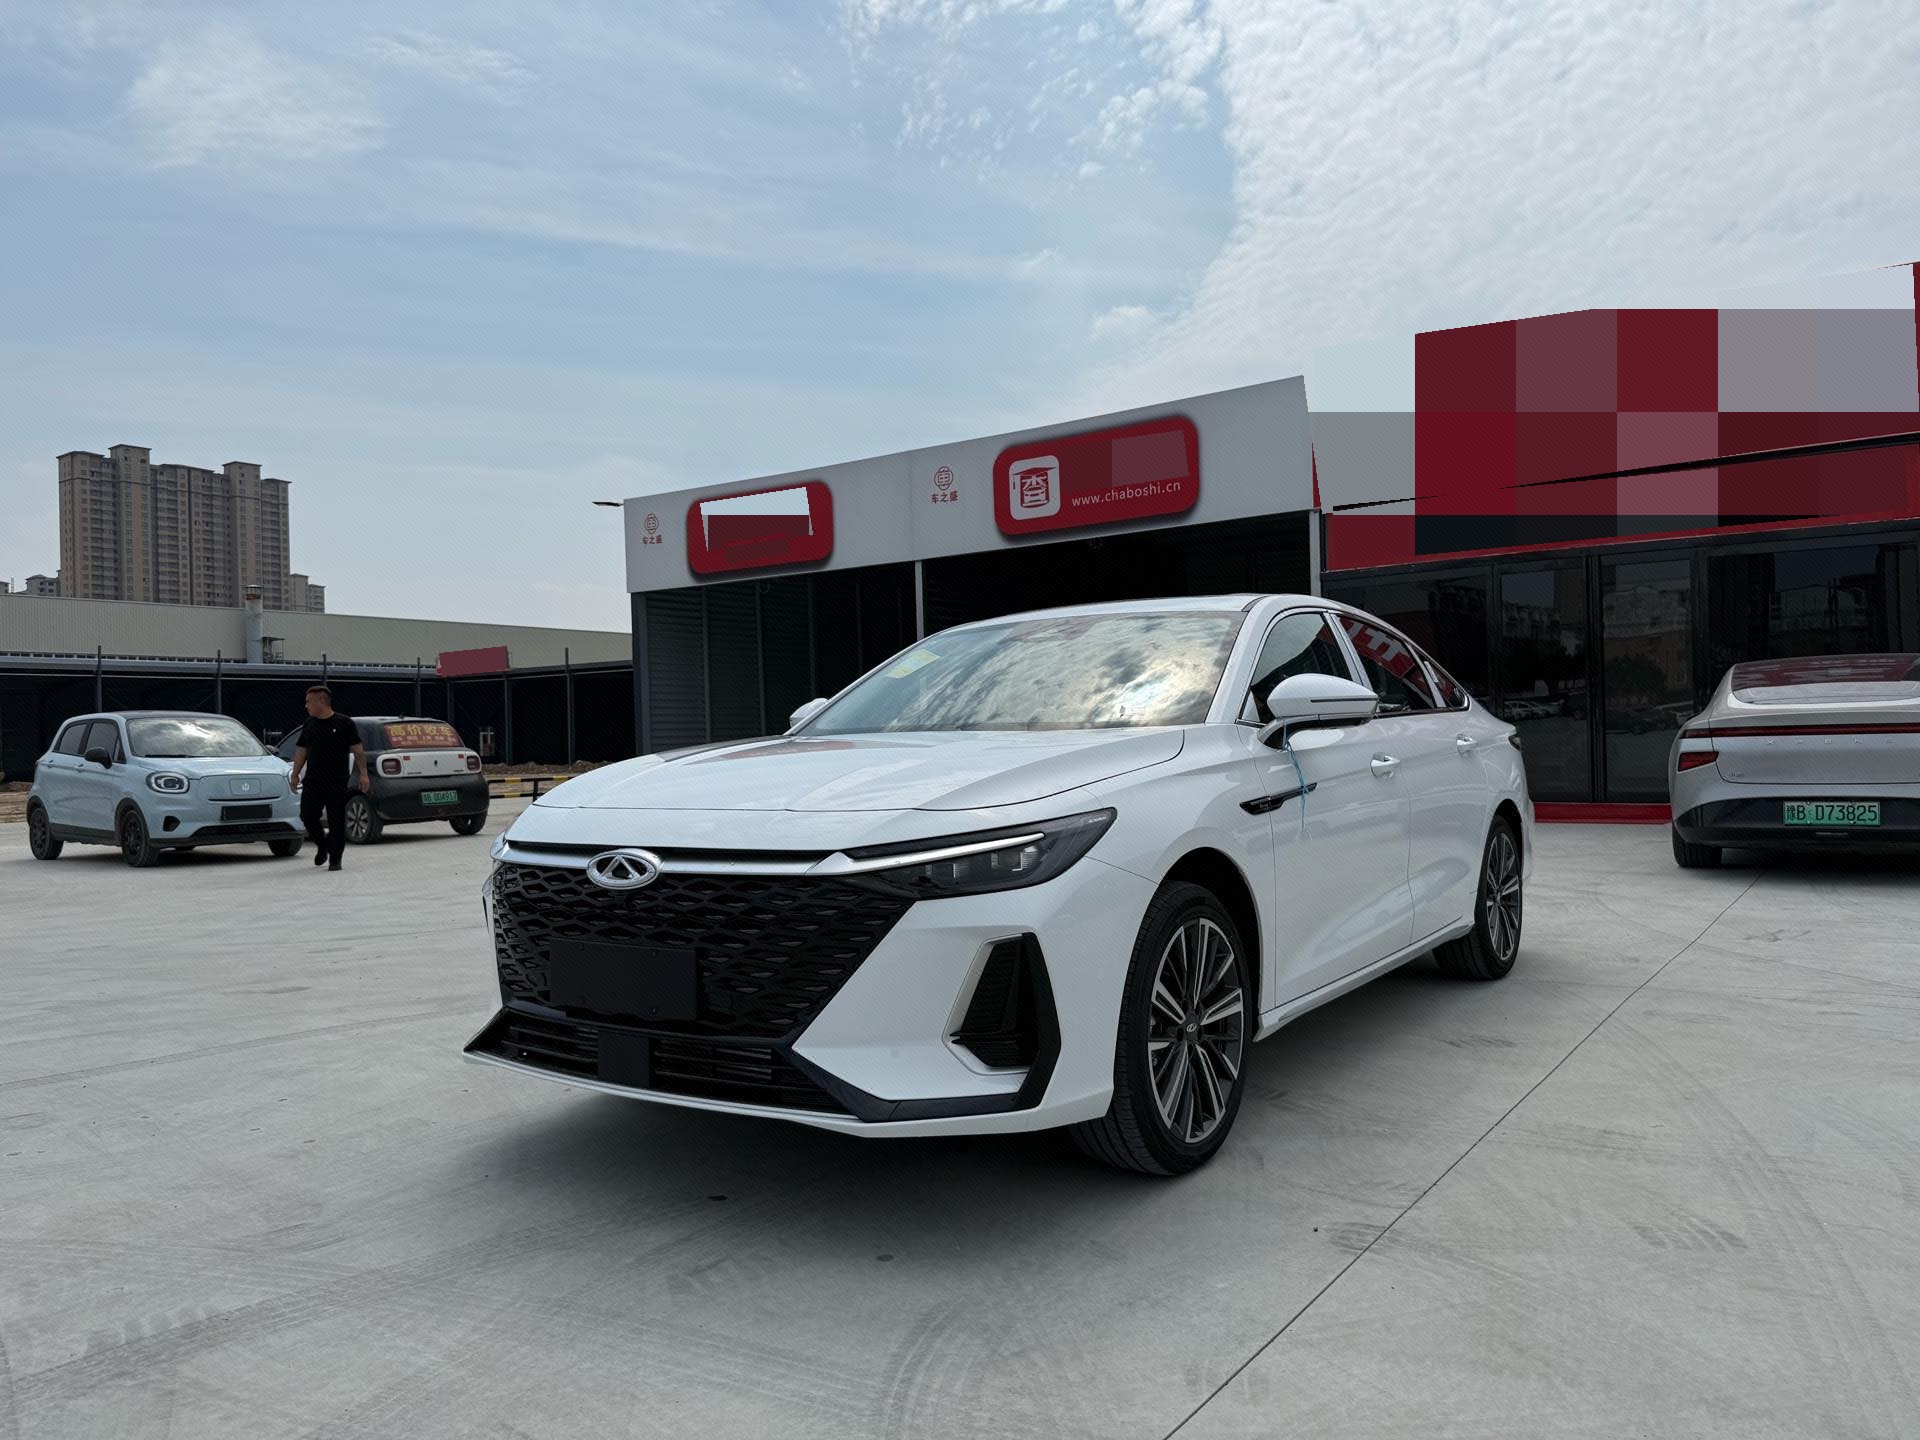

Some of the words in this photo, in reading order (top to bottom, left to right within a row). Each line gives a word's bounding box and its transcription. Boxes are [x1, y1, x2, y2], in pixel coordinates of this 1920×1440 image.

[930, 490, 959, 505] 车之盛
[1071, 482, 1181, 507] www.chaboshi.cn
